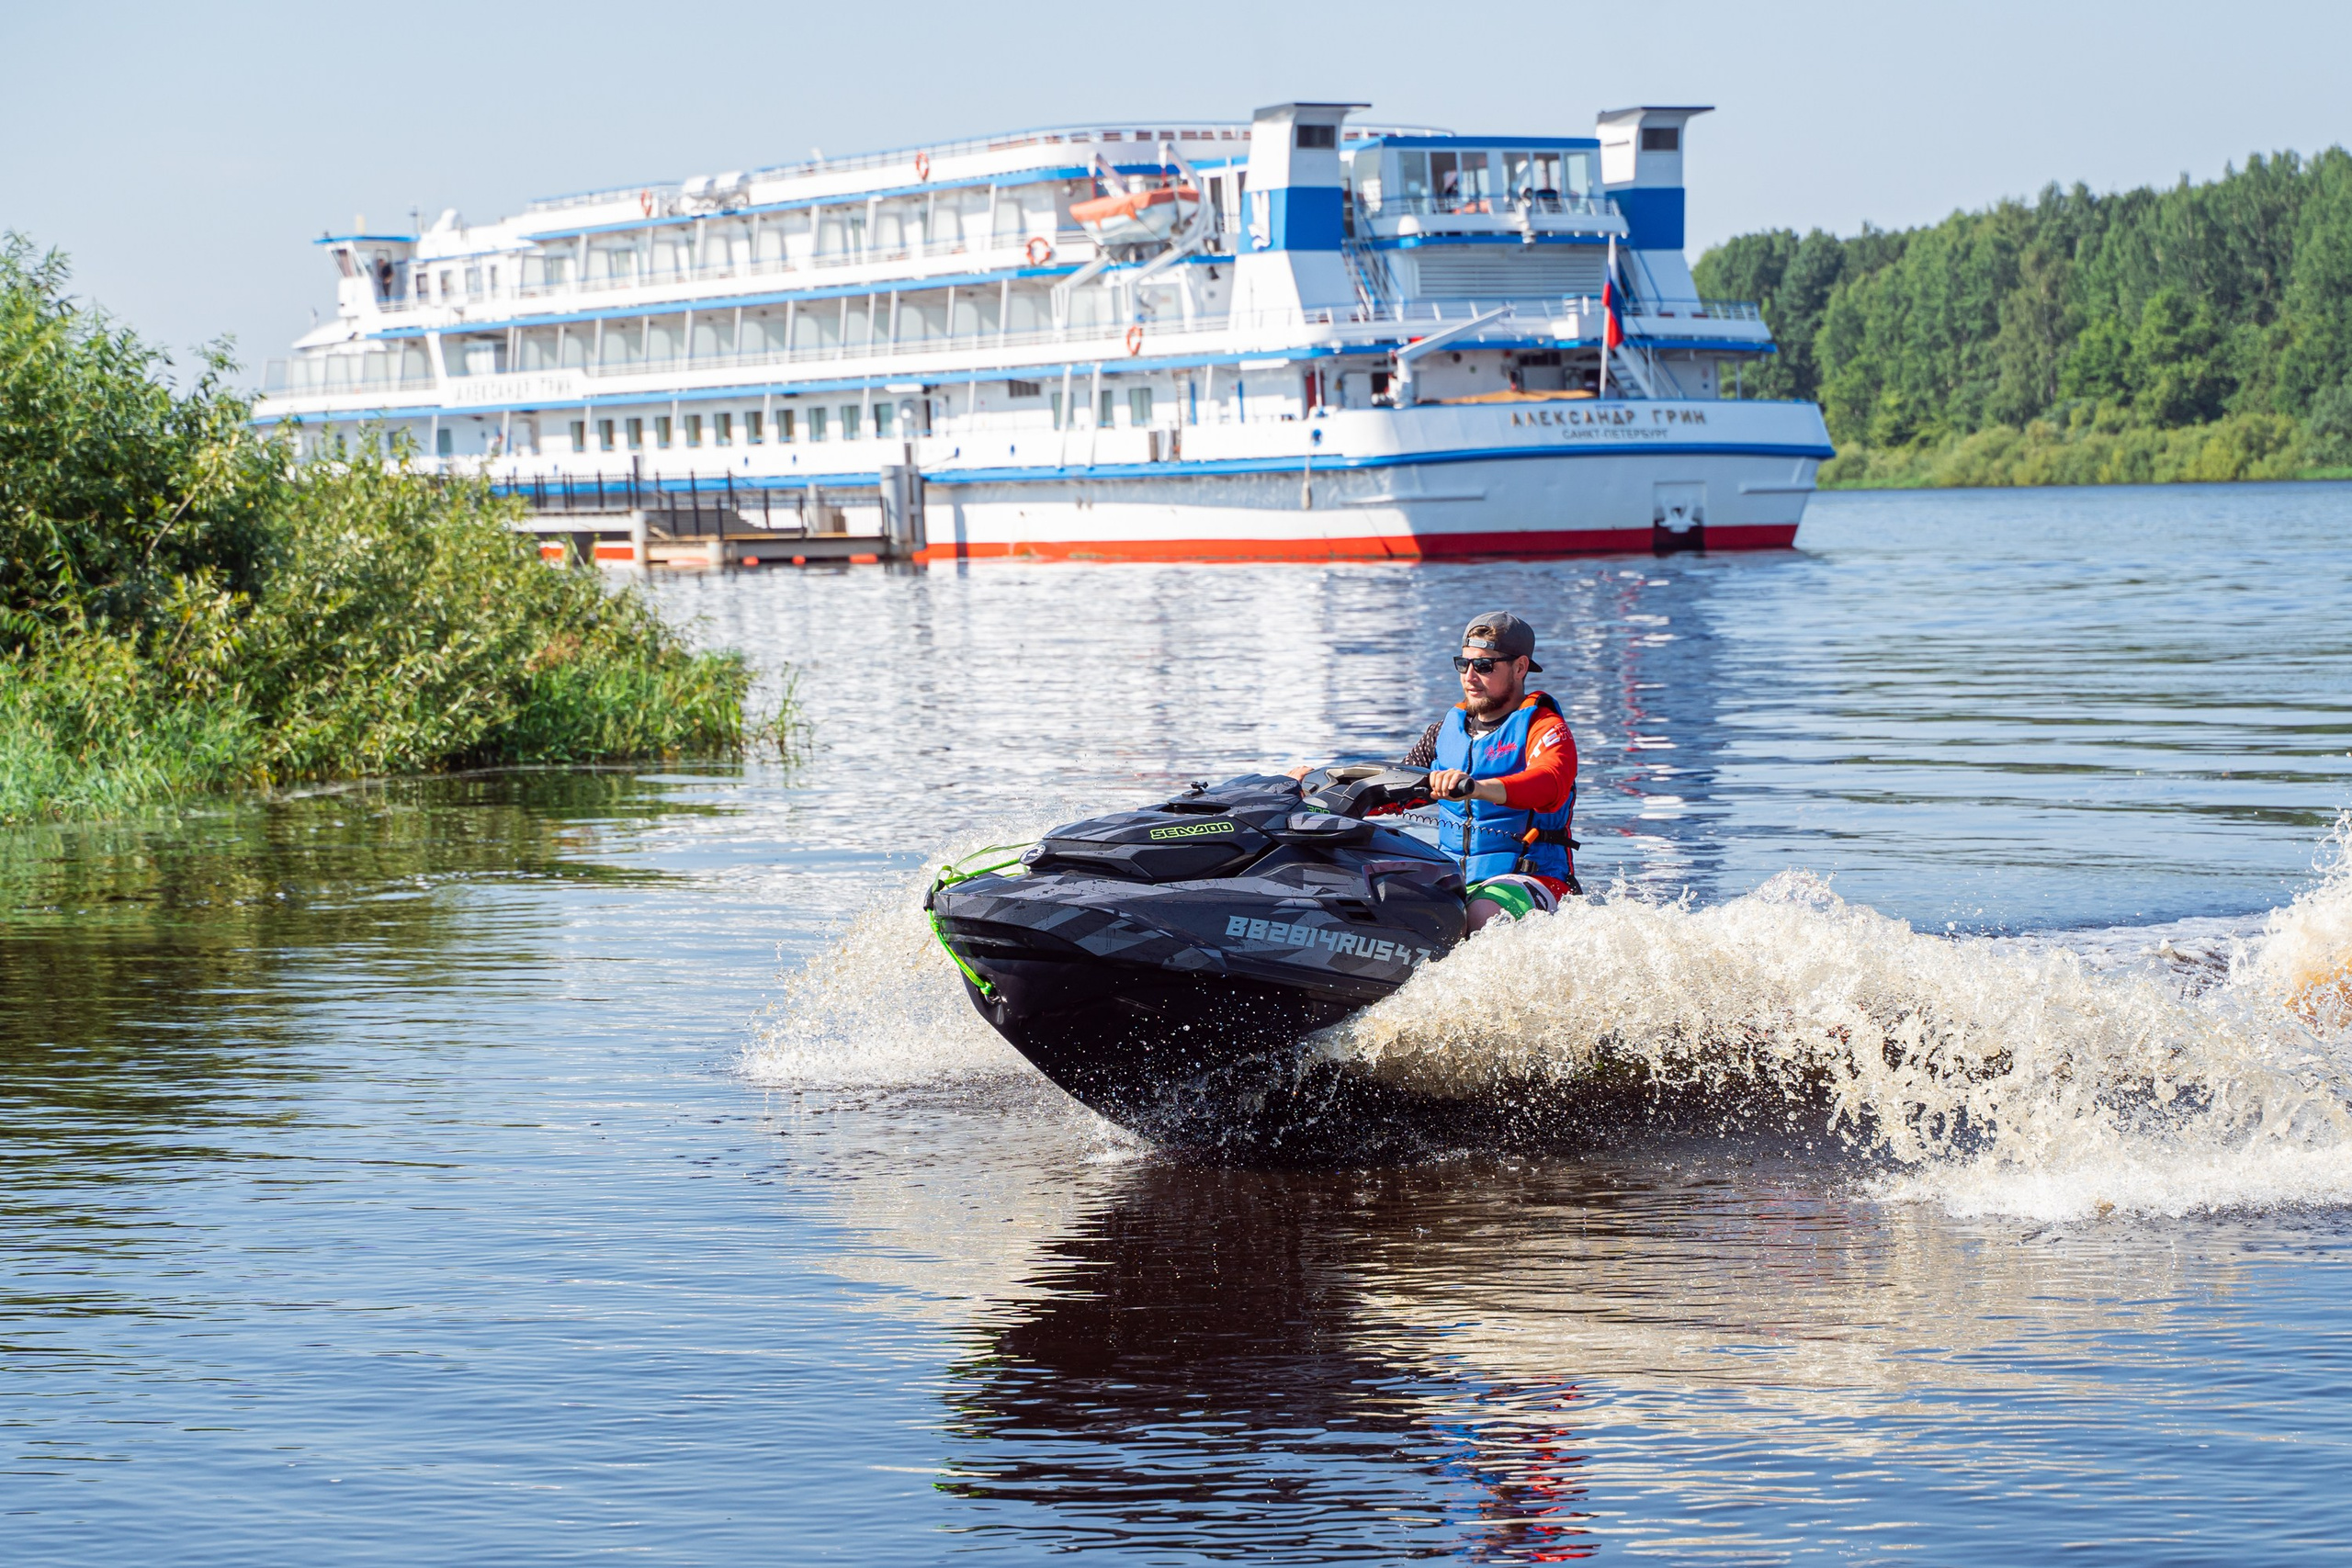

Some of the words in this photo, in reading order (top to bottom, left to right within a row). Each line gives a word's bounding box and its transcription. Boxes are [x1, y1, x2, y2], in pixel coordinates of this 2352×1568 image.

[1510, 410, 1635, 426] АЛЕКСАНДР
[1652, 410, 1706, 424] ГРИН
[1562, 428, 1668, 440] САНКТ-ПЕТЕРБУРГ
